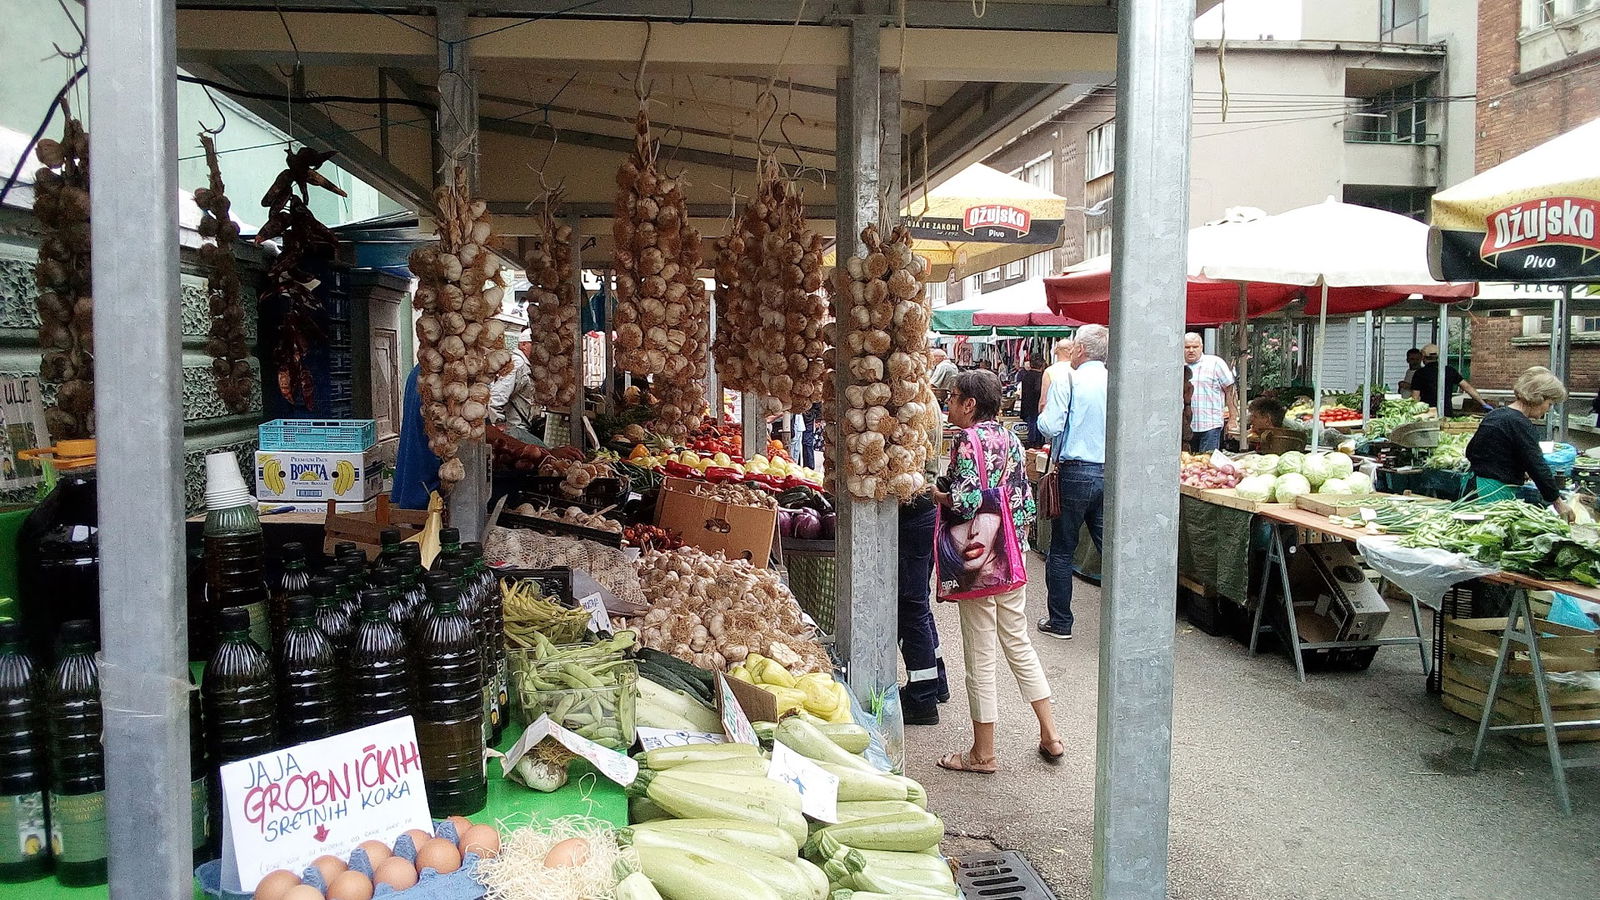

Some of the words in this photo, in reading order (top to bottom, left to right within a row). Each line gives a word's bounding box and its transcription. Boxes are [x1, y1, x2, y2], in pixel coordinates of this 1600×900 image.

[970, 205, 1024, 227] Ožujsko
[1494, 200, 1594, 249] Ožujsko
[922, 221, 930, 229] JE
[932, 222, 960, 231] ZAKON!
[988, 229, 1005, 237] Pivo
[1523, 254, 1556, 268] Pivo
[1513, 283, 1564, 293] PLACA
[4, 380, 32, 405] ULJE
[290, 464, 329, 480] BONITA
[243, 752, 303, 790] JAJA
[264, 800, 348, 842] SRETNIH
[360, 780, 412, 811] KOKA
